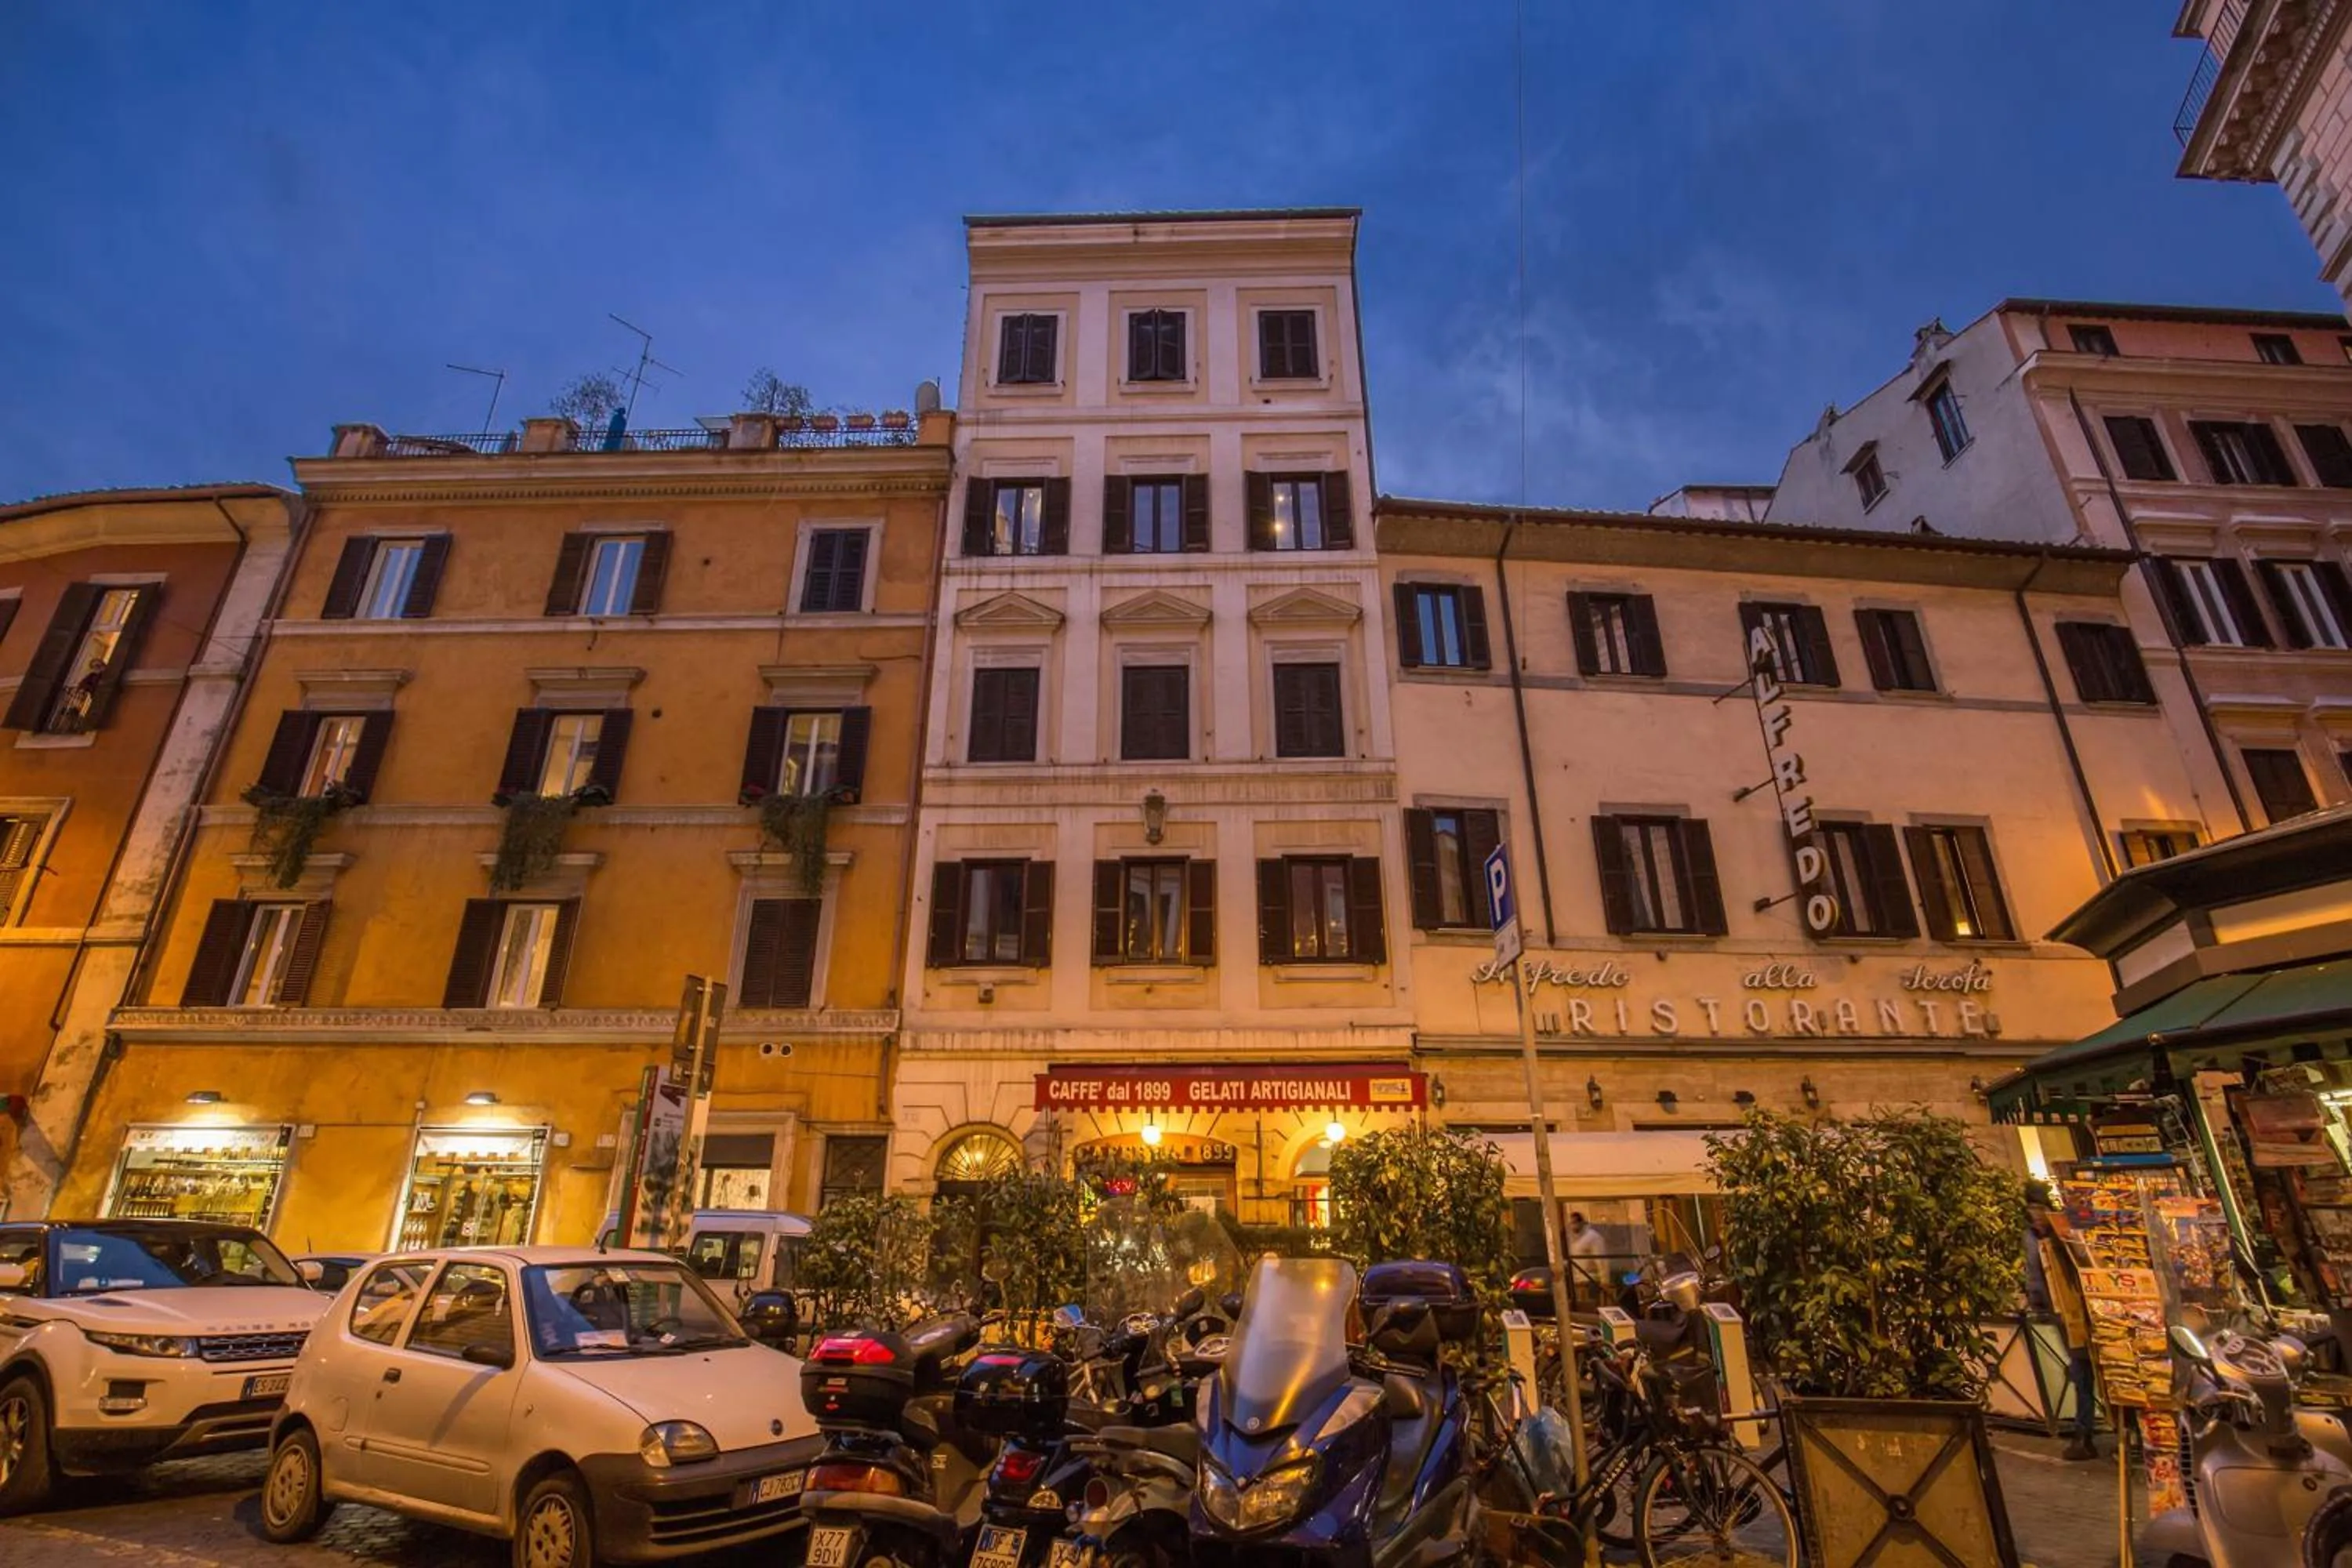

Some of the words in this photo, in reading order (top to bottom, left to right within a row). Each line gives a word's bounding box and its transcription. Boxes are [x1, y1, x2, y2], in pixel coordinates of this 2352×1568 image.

[1750, 626, 1838, 932] ALFREDO
[1490, 858, 1507, 922] P
[1471, 960, 1630, 994] Afredo
[1744, 964, 1817, 989] alla
[1568, 996, 1986, 1035] RISTORANTE
[1049, 1080, 1102, 1100] CAFFE'
[1106, 1081, 1131, 1101] dal
[1134, 1081, 1171, 1101] 1899
[1189, 1080, 1245, 1101] GELATI
[1250, 1080, 1351, 1101] ARTIGIANALI
[815, 1530, 845, 1548] X77
